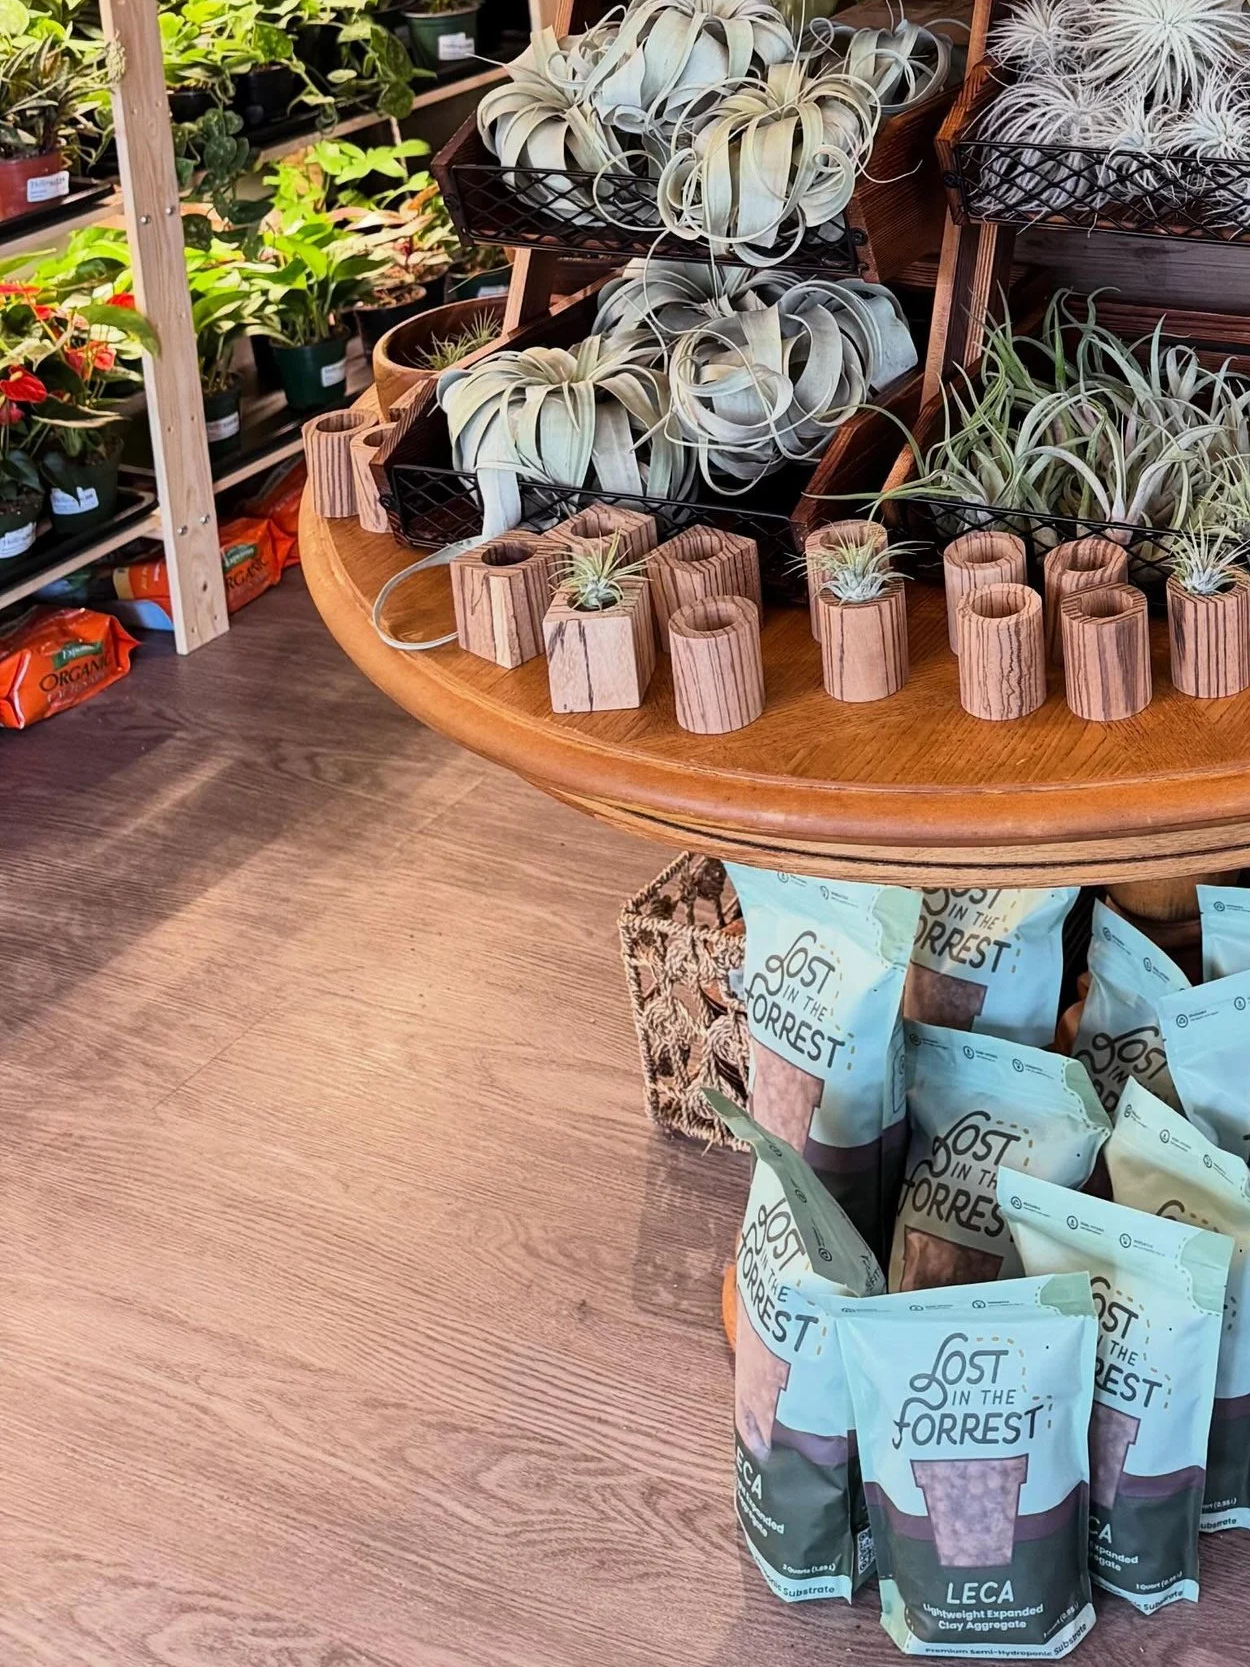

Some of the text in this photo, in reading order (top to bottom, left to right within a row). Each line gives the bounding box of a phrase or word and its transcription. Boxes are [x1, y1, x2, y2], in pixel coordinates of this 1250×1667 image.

[948, 903, 1000, 930] IN THE
[914, 915, 1012, 973] ORREST
[765, 930, 836, 996] LOST
[783, 985, 828, 1022] IN THE
[932, 1111, 1021, 1178] LOST
[950, 1161, 998, 1190] IN TH
[898, 1159, 1014, 1243] FORRES
[768, 1266, 791, 1303] THE
[1108, 1339, 1139, 1367] THE
[909, 1332, 1010, 1411] LOST
[951, 1389, 1017, 1406] IN THE
[736, 1446, 763, 1501] ECA
[1200, 1518, 1237, 1529] ubstrate
[1095, 1545, 1139, 1565] xpanded
[783, 1585, 836, 1598] Substrate
[946, 1580, 1015, 1605] LECA
[923, 1603, 1044, 1620] Lightweight Expanded
[938, 1620, 1027, 1632] Clay Aggregate
[1053, 1623, 1087, 1656] Substrate
